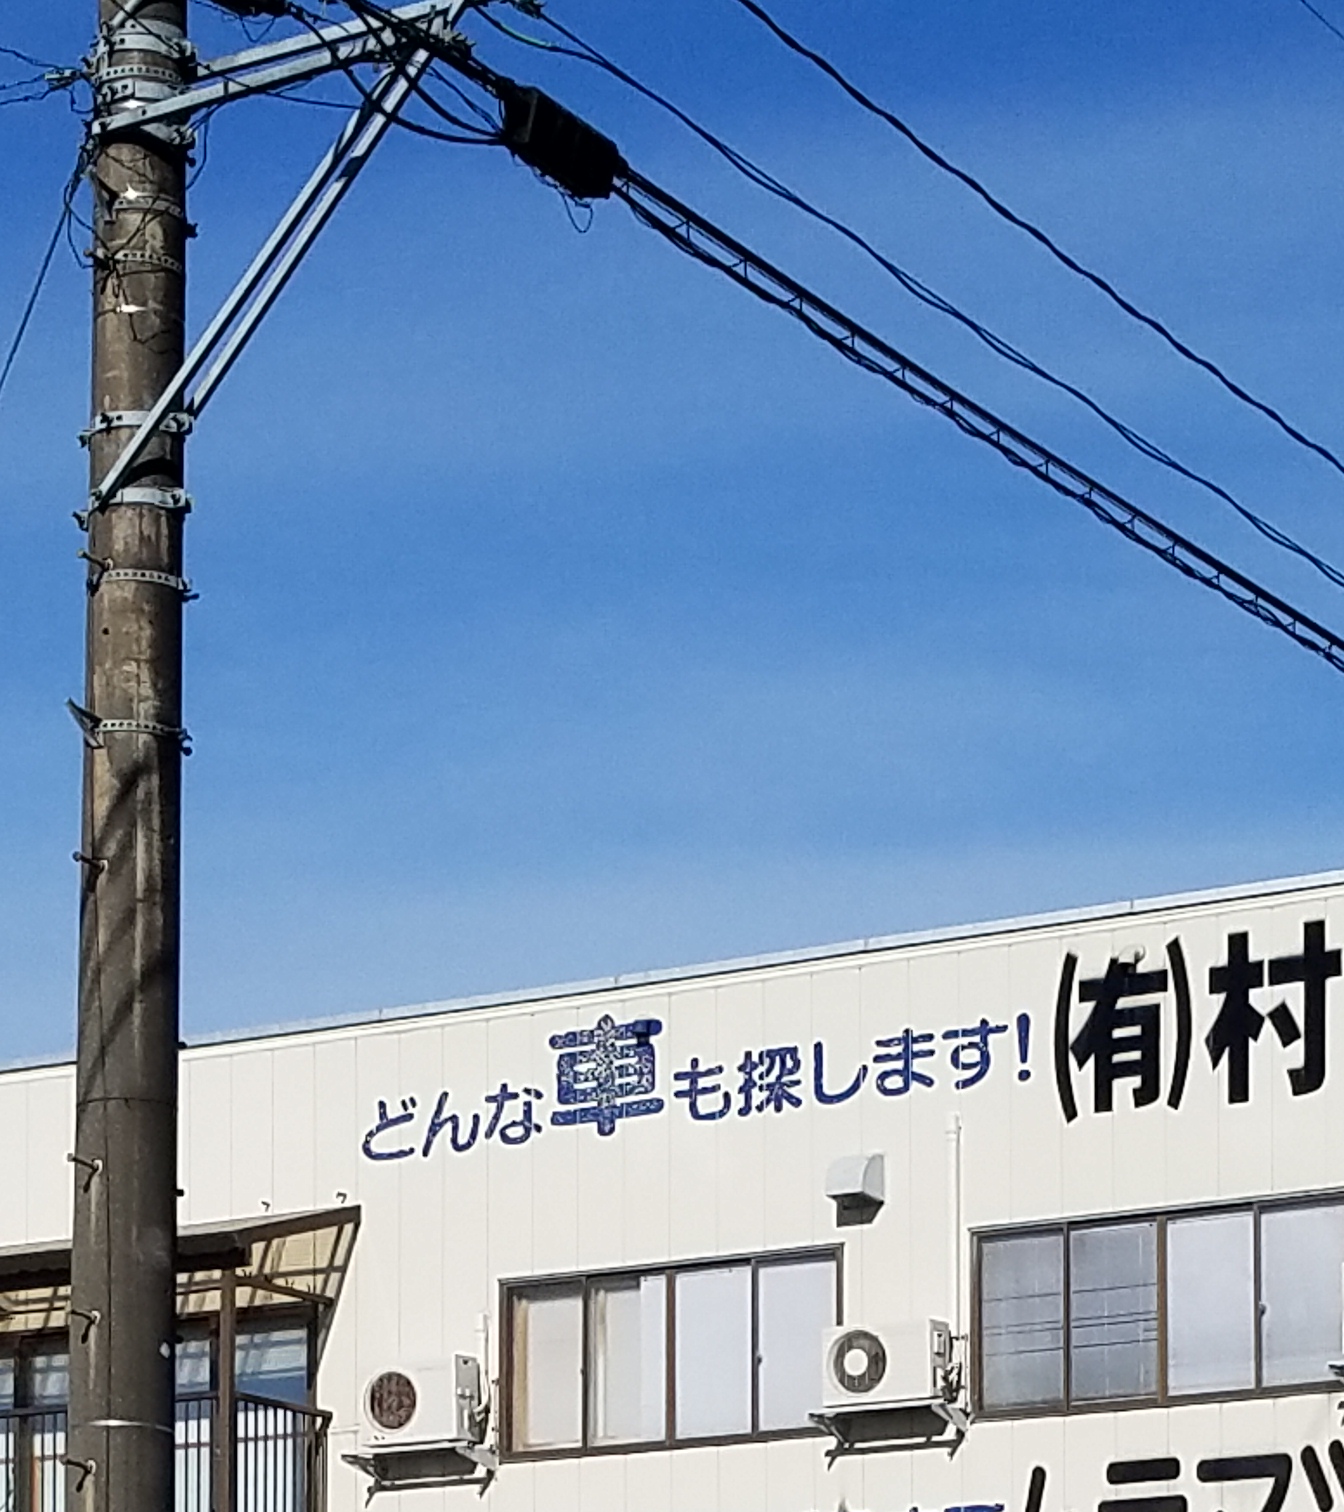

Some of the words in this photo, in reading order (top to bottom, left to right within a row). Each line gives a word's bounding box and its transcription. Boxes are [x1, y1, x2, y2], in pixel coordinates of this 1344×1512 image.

[361, 1013, 1032, 1161] どんな車も探します!
